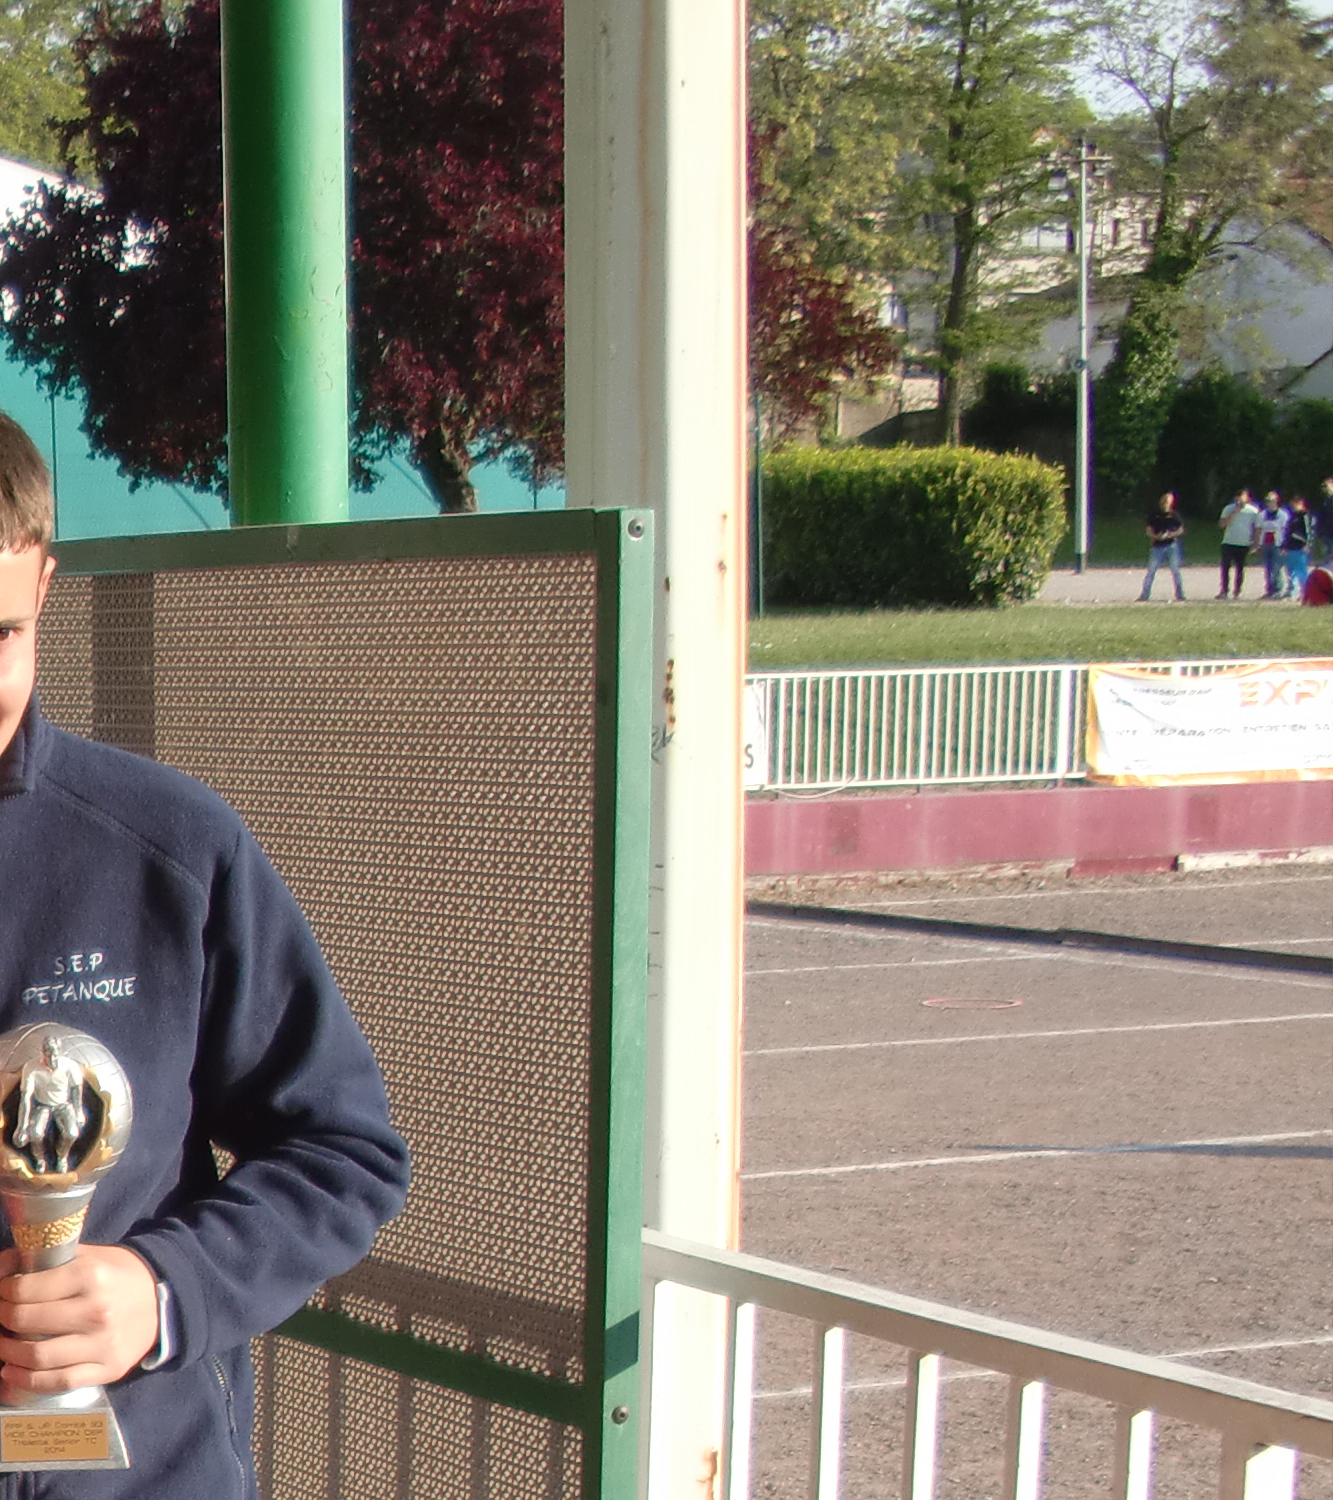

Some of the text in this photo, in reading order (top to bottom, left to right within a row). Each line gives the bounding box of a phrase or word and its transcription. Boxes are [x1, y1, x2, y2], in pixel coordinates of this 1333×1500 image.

[54, 952, 103, 975] S.E.P
[21, 976, 137, 1004] PETANQUE
[29, 1429, 81, 1438] CHAMPION
